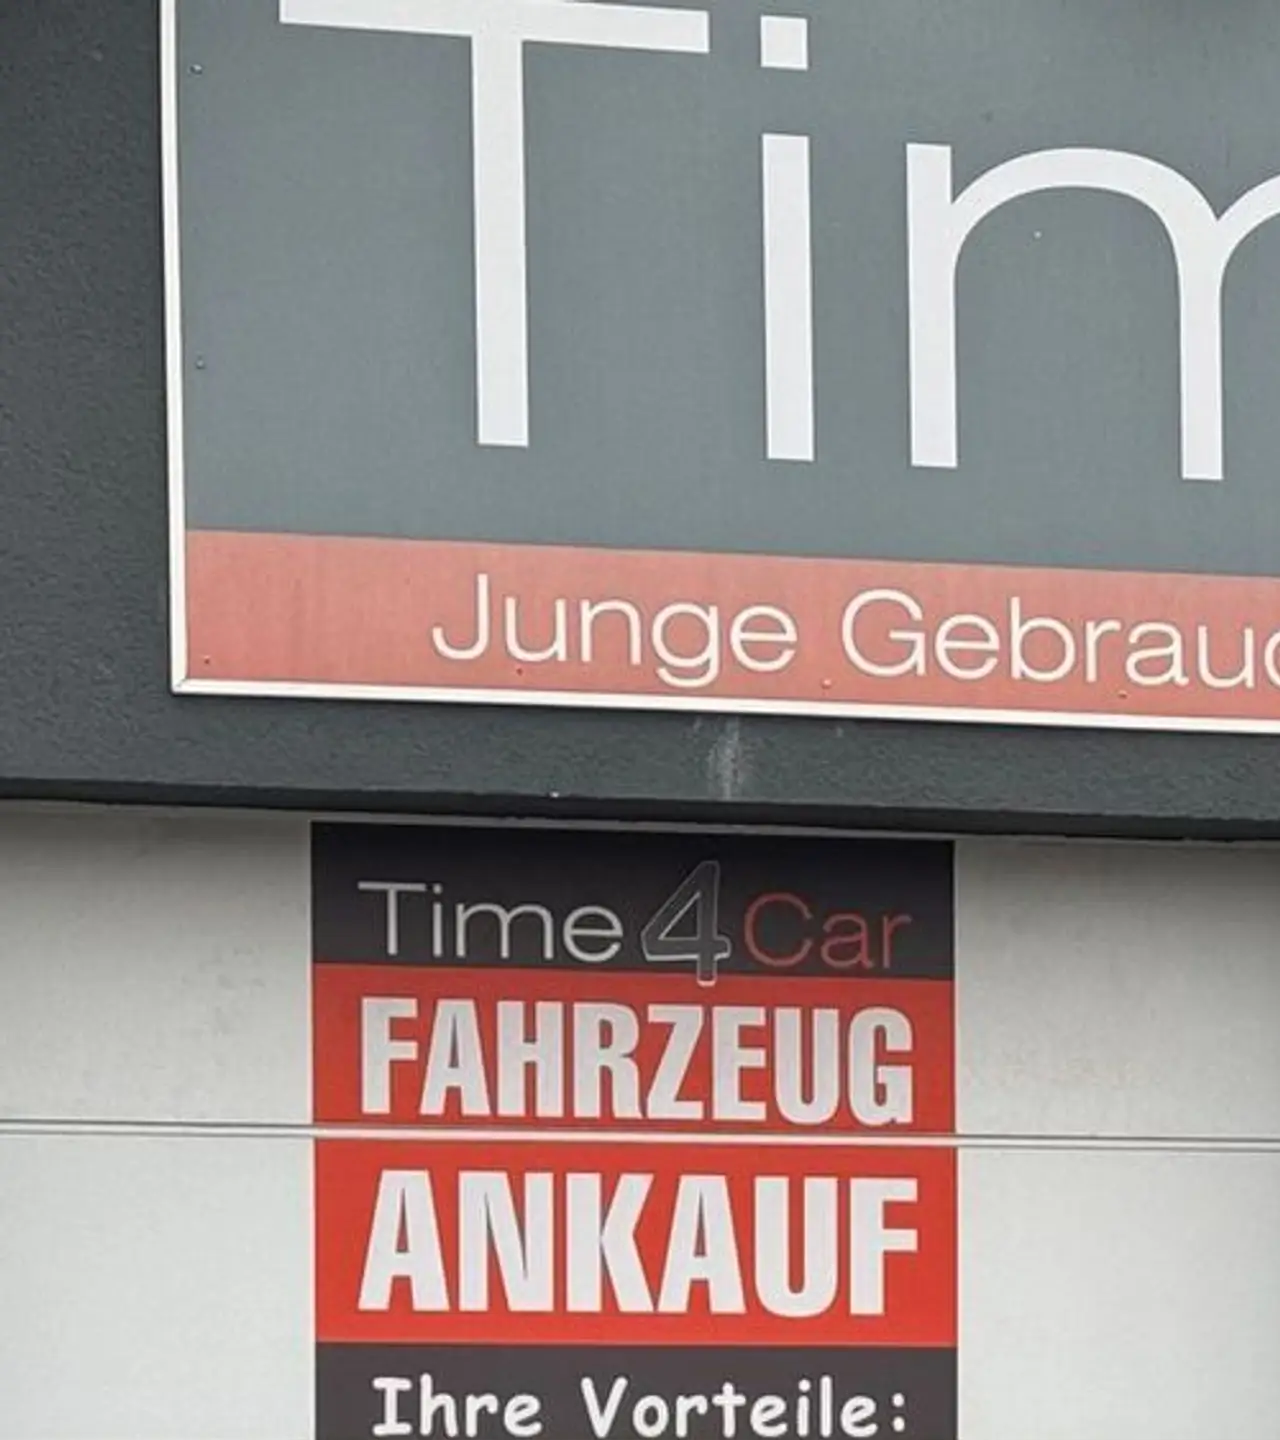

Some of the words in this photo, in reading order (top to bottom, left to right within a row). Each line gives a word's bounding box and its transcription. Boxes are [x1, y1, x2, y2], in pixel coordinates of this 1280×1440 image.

[431, 573, 798, 689] Junge
[358, 880, 624, 962] Time
[641, 860, 732, 986] 4
[744, 892, 912, 969] Car
[361, 996, 914, 1126] FAHRZEUG
[358, 1169, 918, 1318] ANKAUF
[372, 1373, 543, 1438] Ihre
[580, 1374, 906, 1439] Vorteile:
